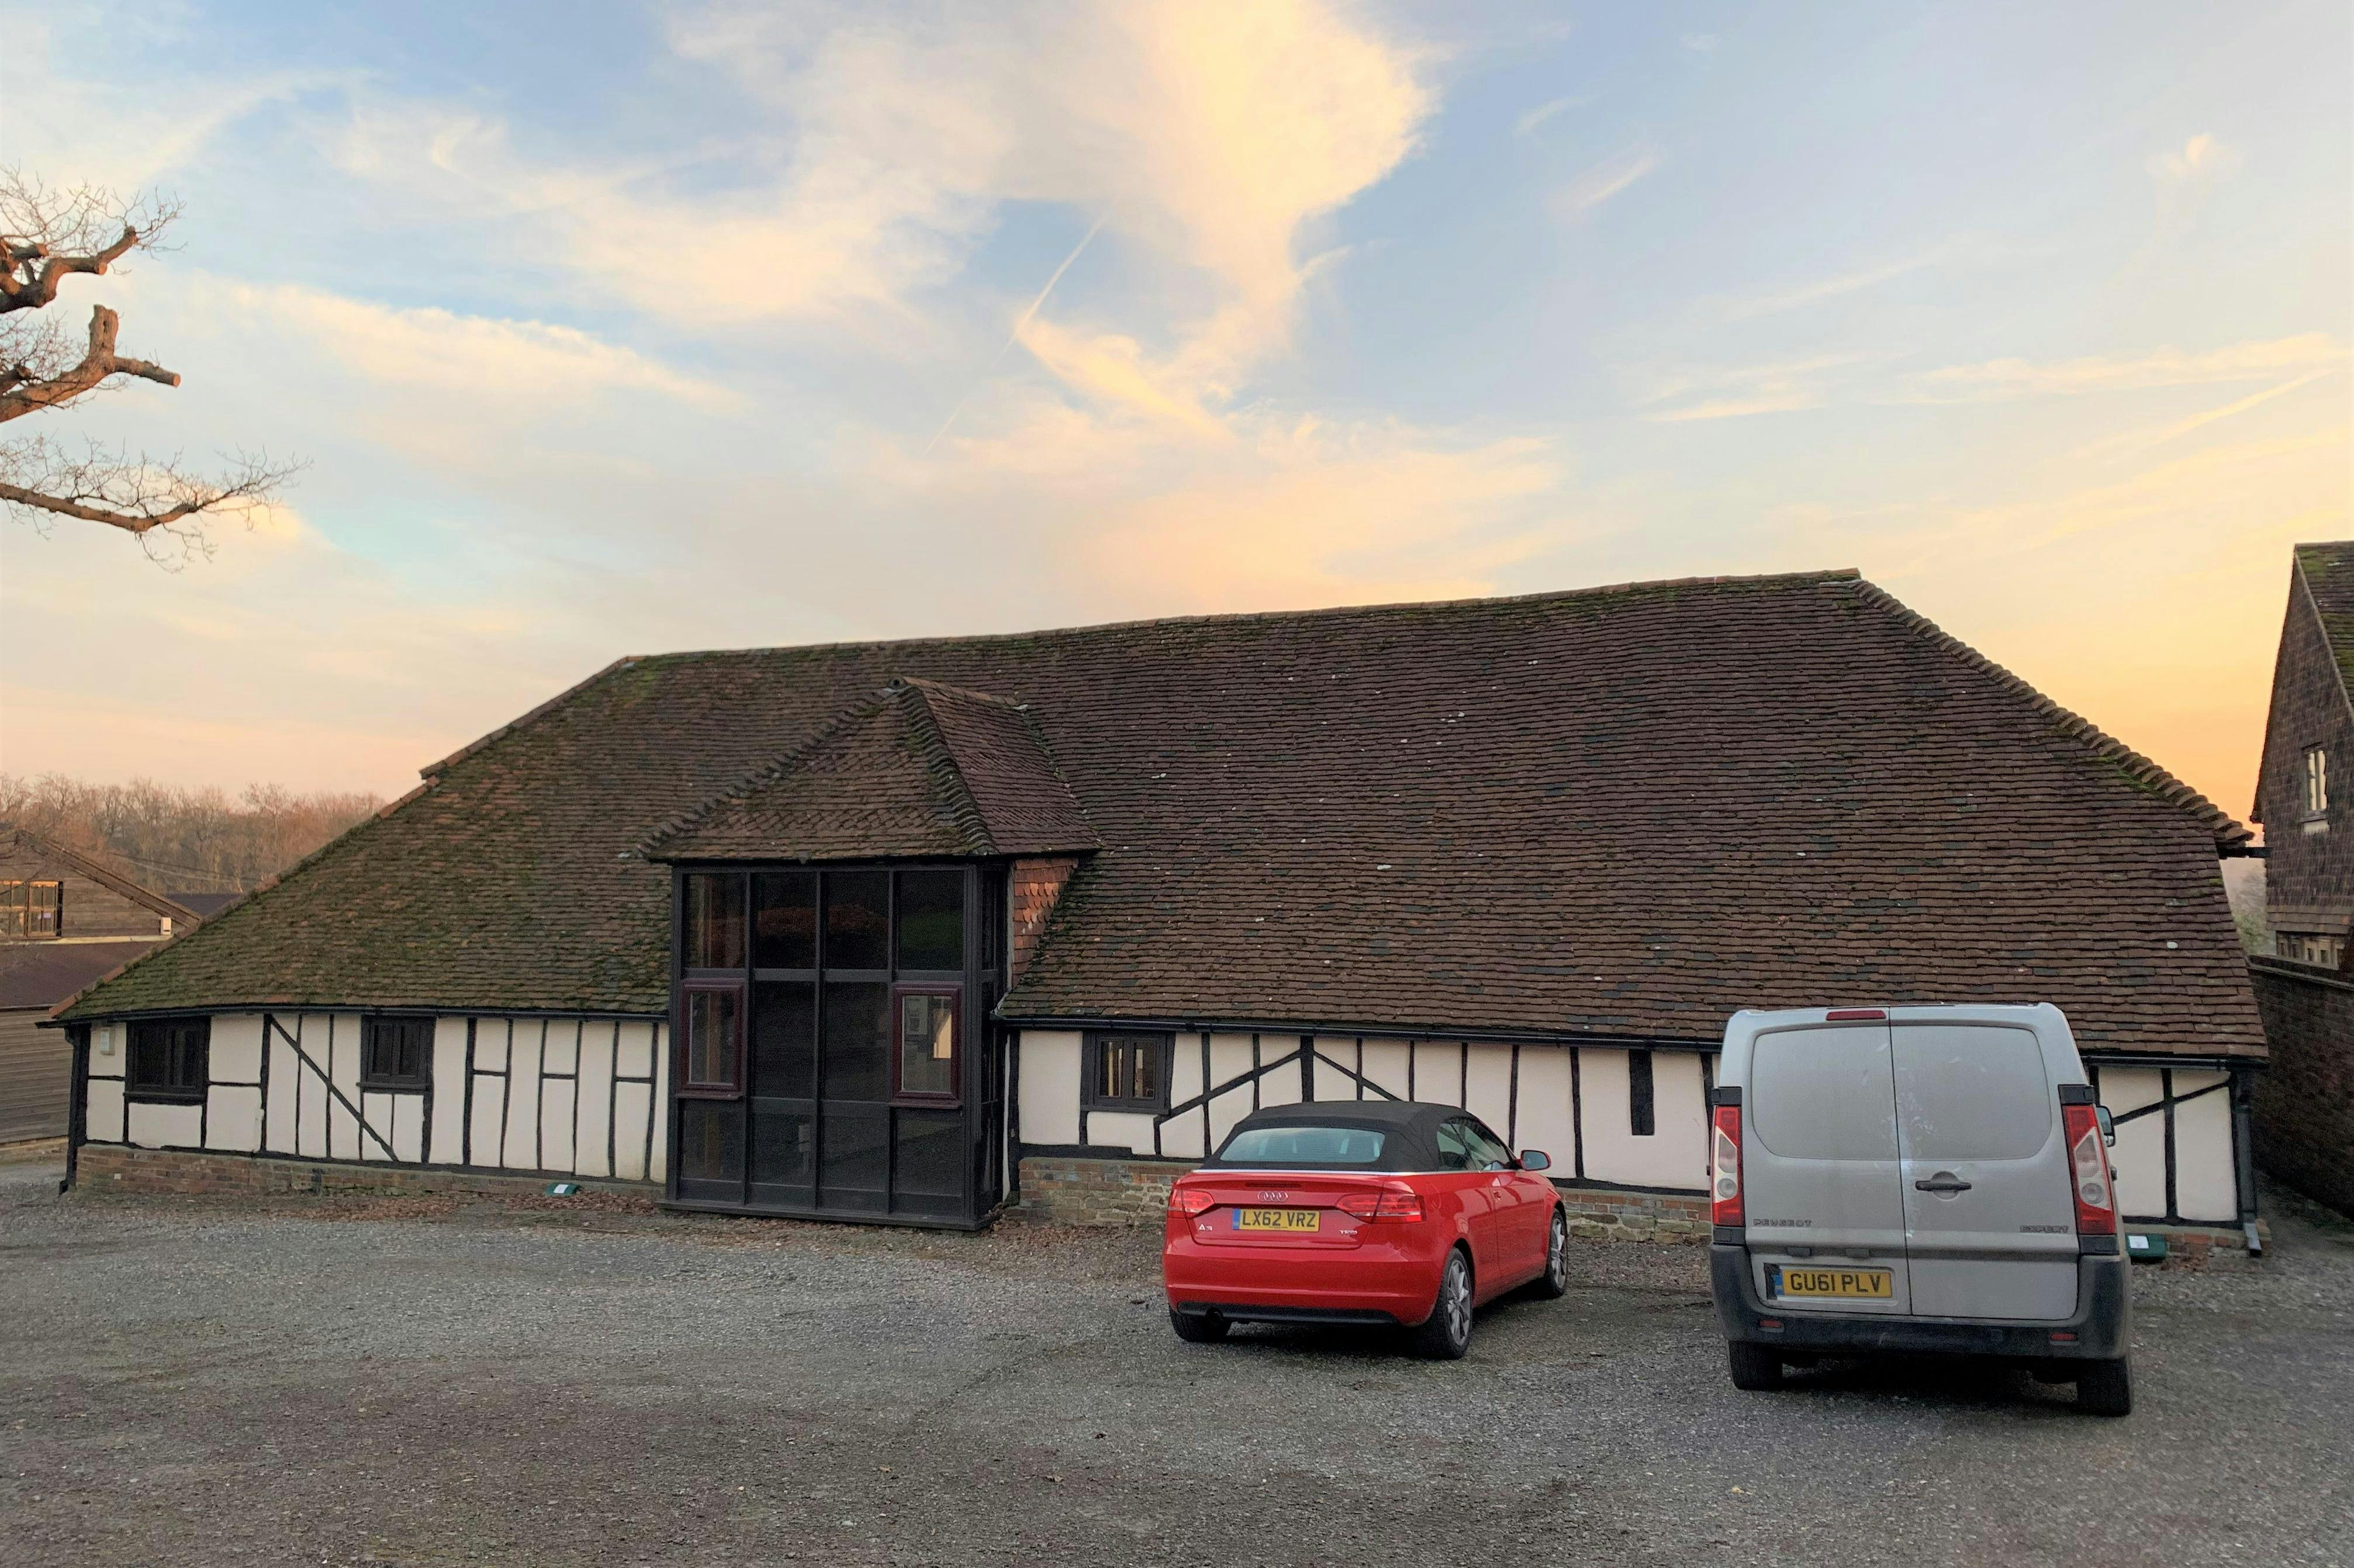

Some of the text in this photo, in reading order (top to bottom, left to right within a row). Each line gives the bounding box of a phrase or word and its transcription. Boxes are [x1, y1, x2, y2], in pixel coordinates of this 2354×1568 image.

[1243, 1211, 1316, 1227] LX62 VRZ
[1753, 1218, 1812, 1227] PEUGEOT
[2020, 1224, 2069, 1233] EXPERT
[1790, 1273, 1881, 1293] GU61 PLV
